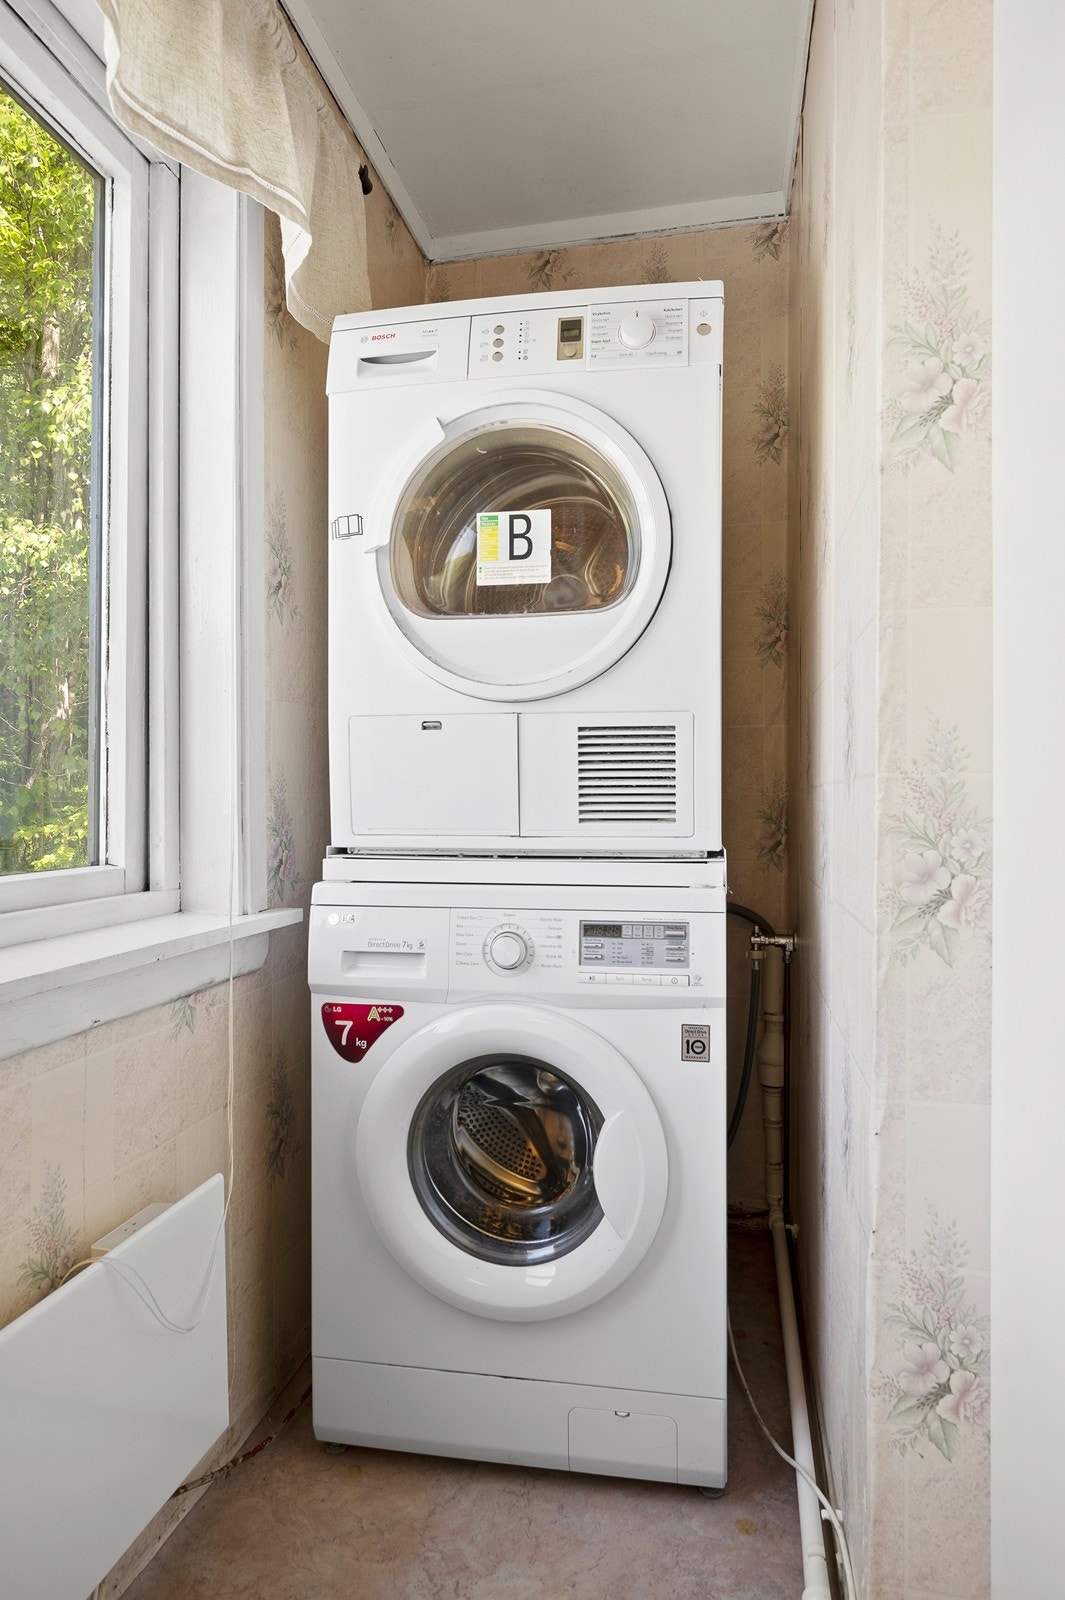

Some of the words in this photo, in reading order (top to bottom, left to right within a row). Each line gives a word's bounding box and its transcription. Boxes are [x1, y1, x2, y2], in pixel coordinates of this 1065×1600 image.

[371, 333, 396, 341] BOSCH
[509, 514, 533, 560] B
[341, 914, 355, 923] LG
[334, 1020, 354, 1046] 7
[355, 1037, 367, 1049] kg
[686, 1039, 706, 1055] 10
